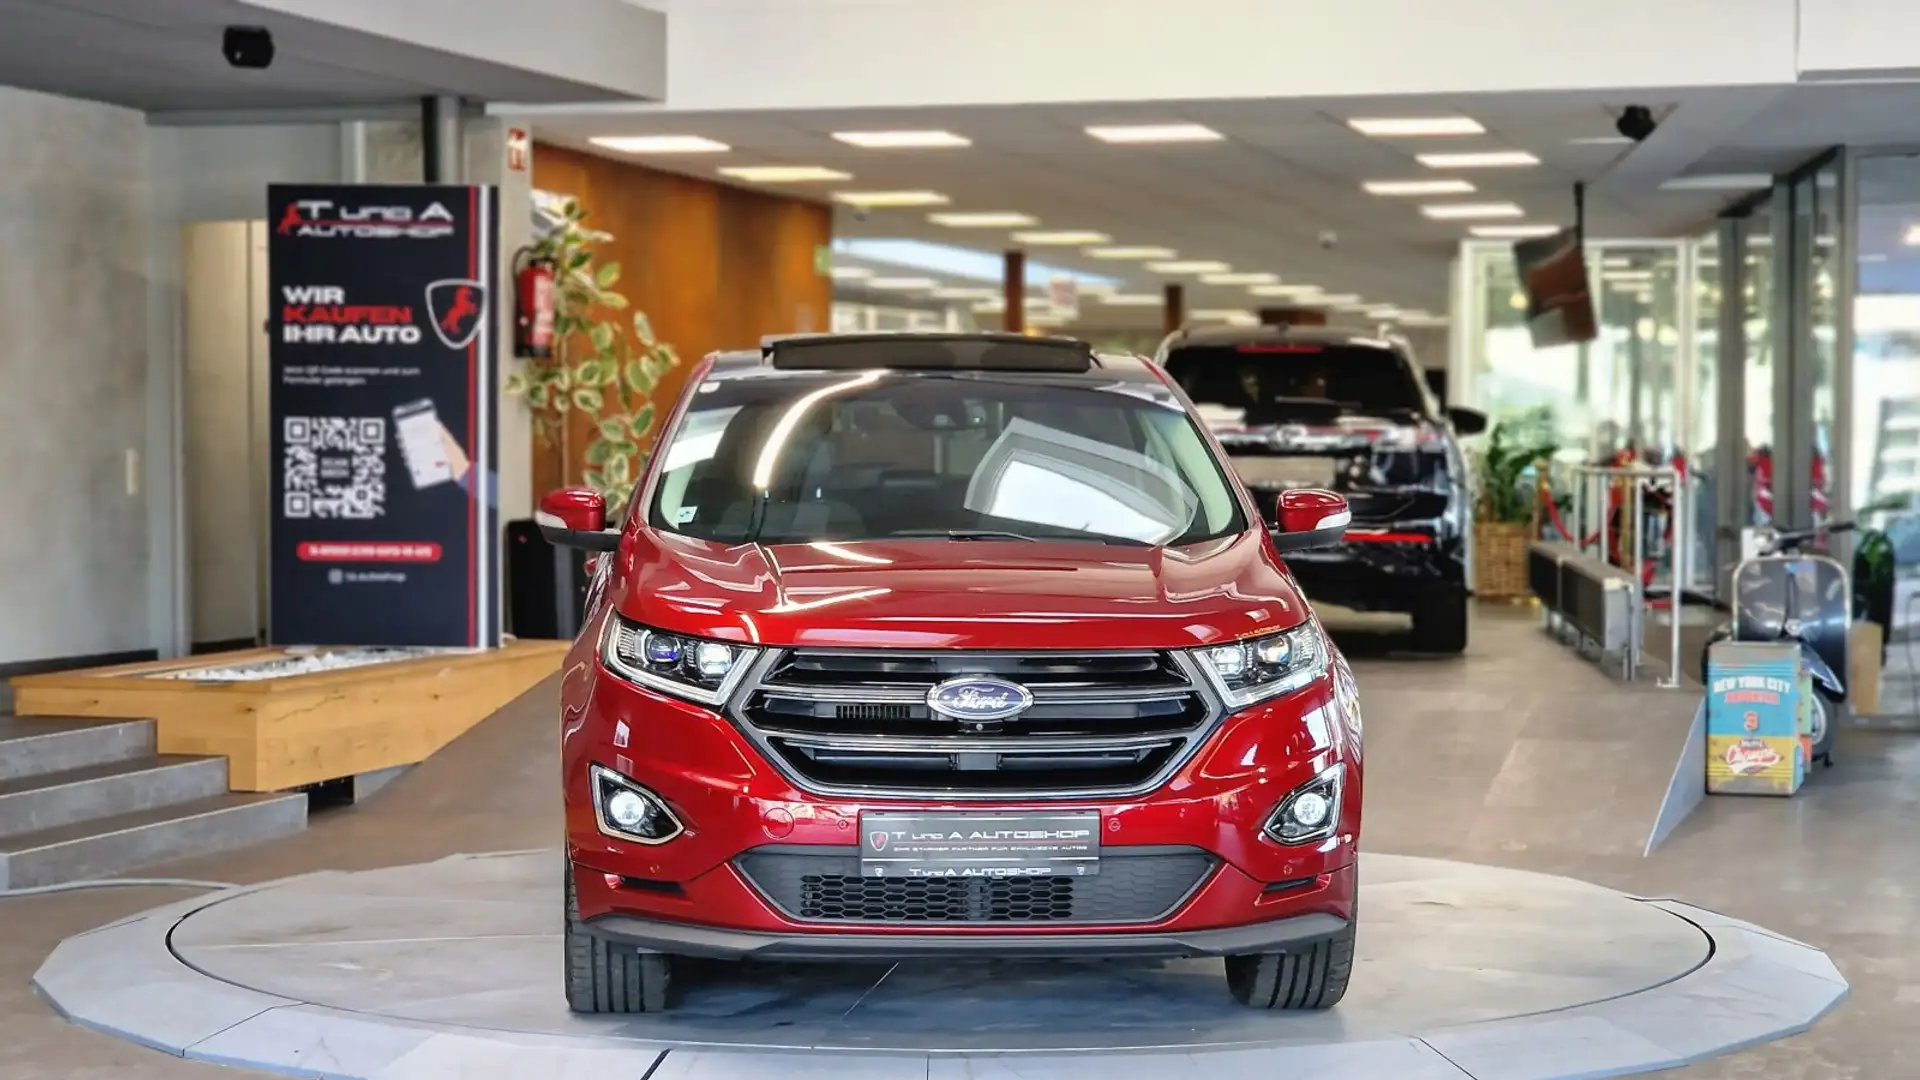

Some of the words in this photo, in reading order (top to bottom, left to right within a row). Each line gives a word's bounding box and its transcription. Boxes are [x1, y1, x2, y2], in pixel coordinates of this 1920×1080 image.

[296, 200, 334, 219] T
[339, 206, 413, 221] und
[419, 201, 454, 221] A
[297, 225, 454, 238] AUTOSHOP
[282, 286, 345, 304] WIR
[283, 305, 413, 324] KAUFEN
[283, 325, 336, 343] IHR
[338, 325, 421, 343] AUTO
[1738, 676, 1766, 689] YORK
[1766, 677, 1791, 694] CITY
[951, 686, 1009, 709] Ford
[891, 831, 907, 840] T
[911, 832, 944, 840] und
[948, 831, 963, 840] A
[968, 830, 1090, 839] AUTOSHOP
[961, 867, 1052, 877] AUTOSHOP
